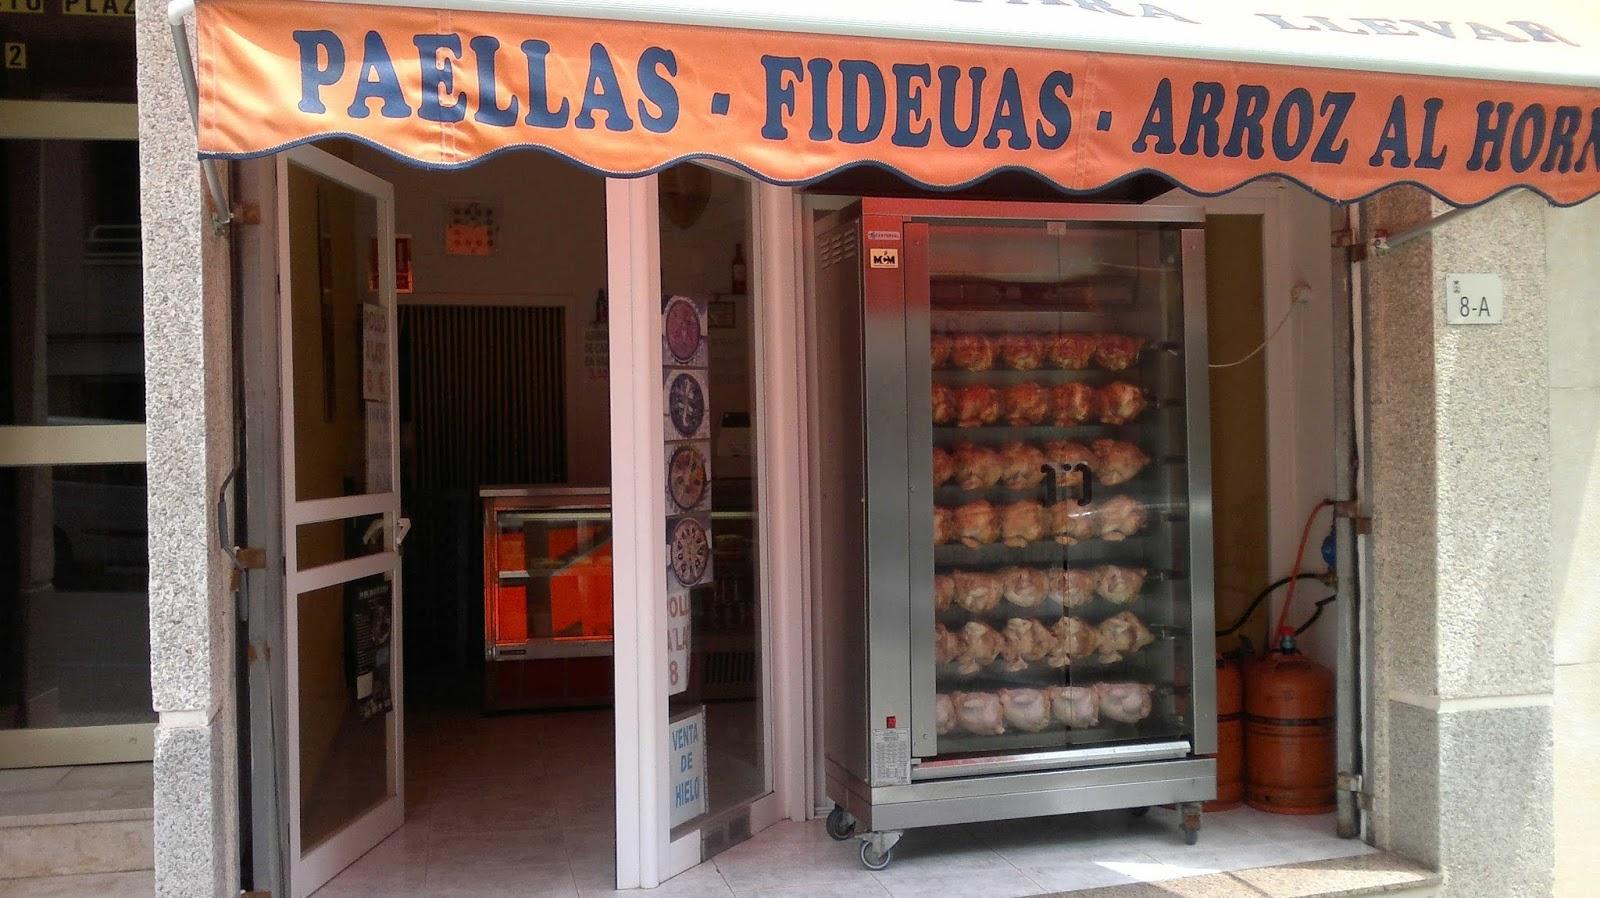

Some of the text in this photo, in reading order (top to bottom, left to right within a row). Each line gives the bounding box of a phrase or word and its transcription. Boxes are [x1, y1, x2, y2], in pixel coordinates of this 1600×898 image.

[1255, 13, 1580, 47] LLEVAR
[9, 45, 22, 66] 2
[293, 29, 679, 133] PAELLAS
[760, 54, 1074, 150] FIDEUAS
[1131, 77, 1356, 164] ARROZ
[1369, 94, 1447, 169] AL
[873, 255, 896, 265] MCM
[1460, 296, 1490, 317] 8-A
[671, 722, 699, 751] VENTA
[680, 752, 693, 772] DE
[675, 776, 701, 808] HIELO
